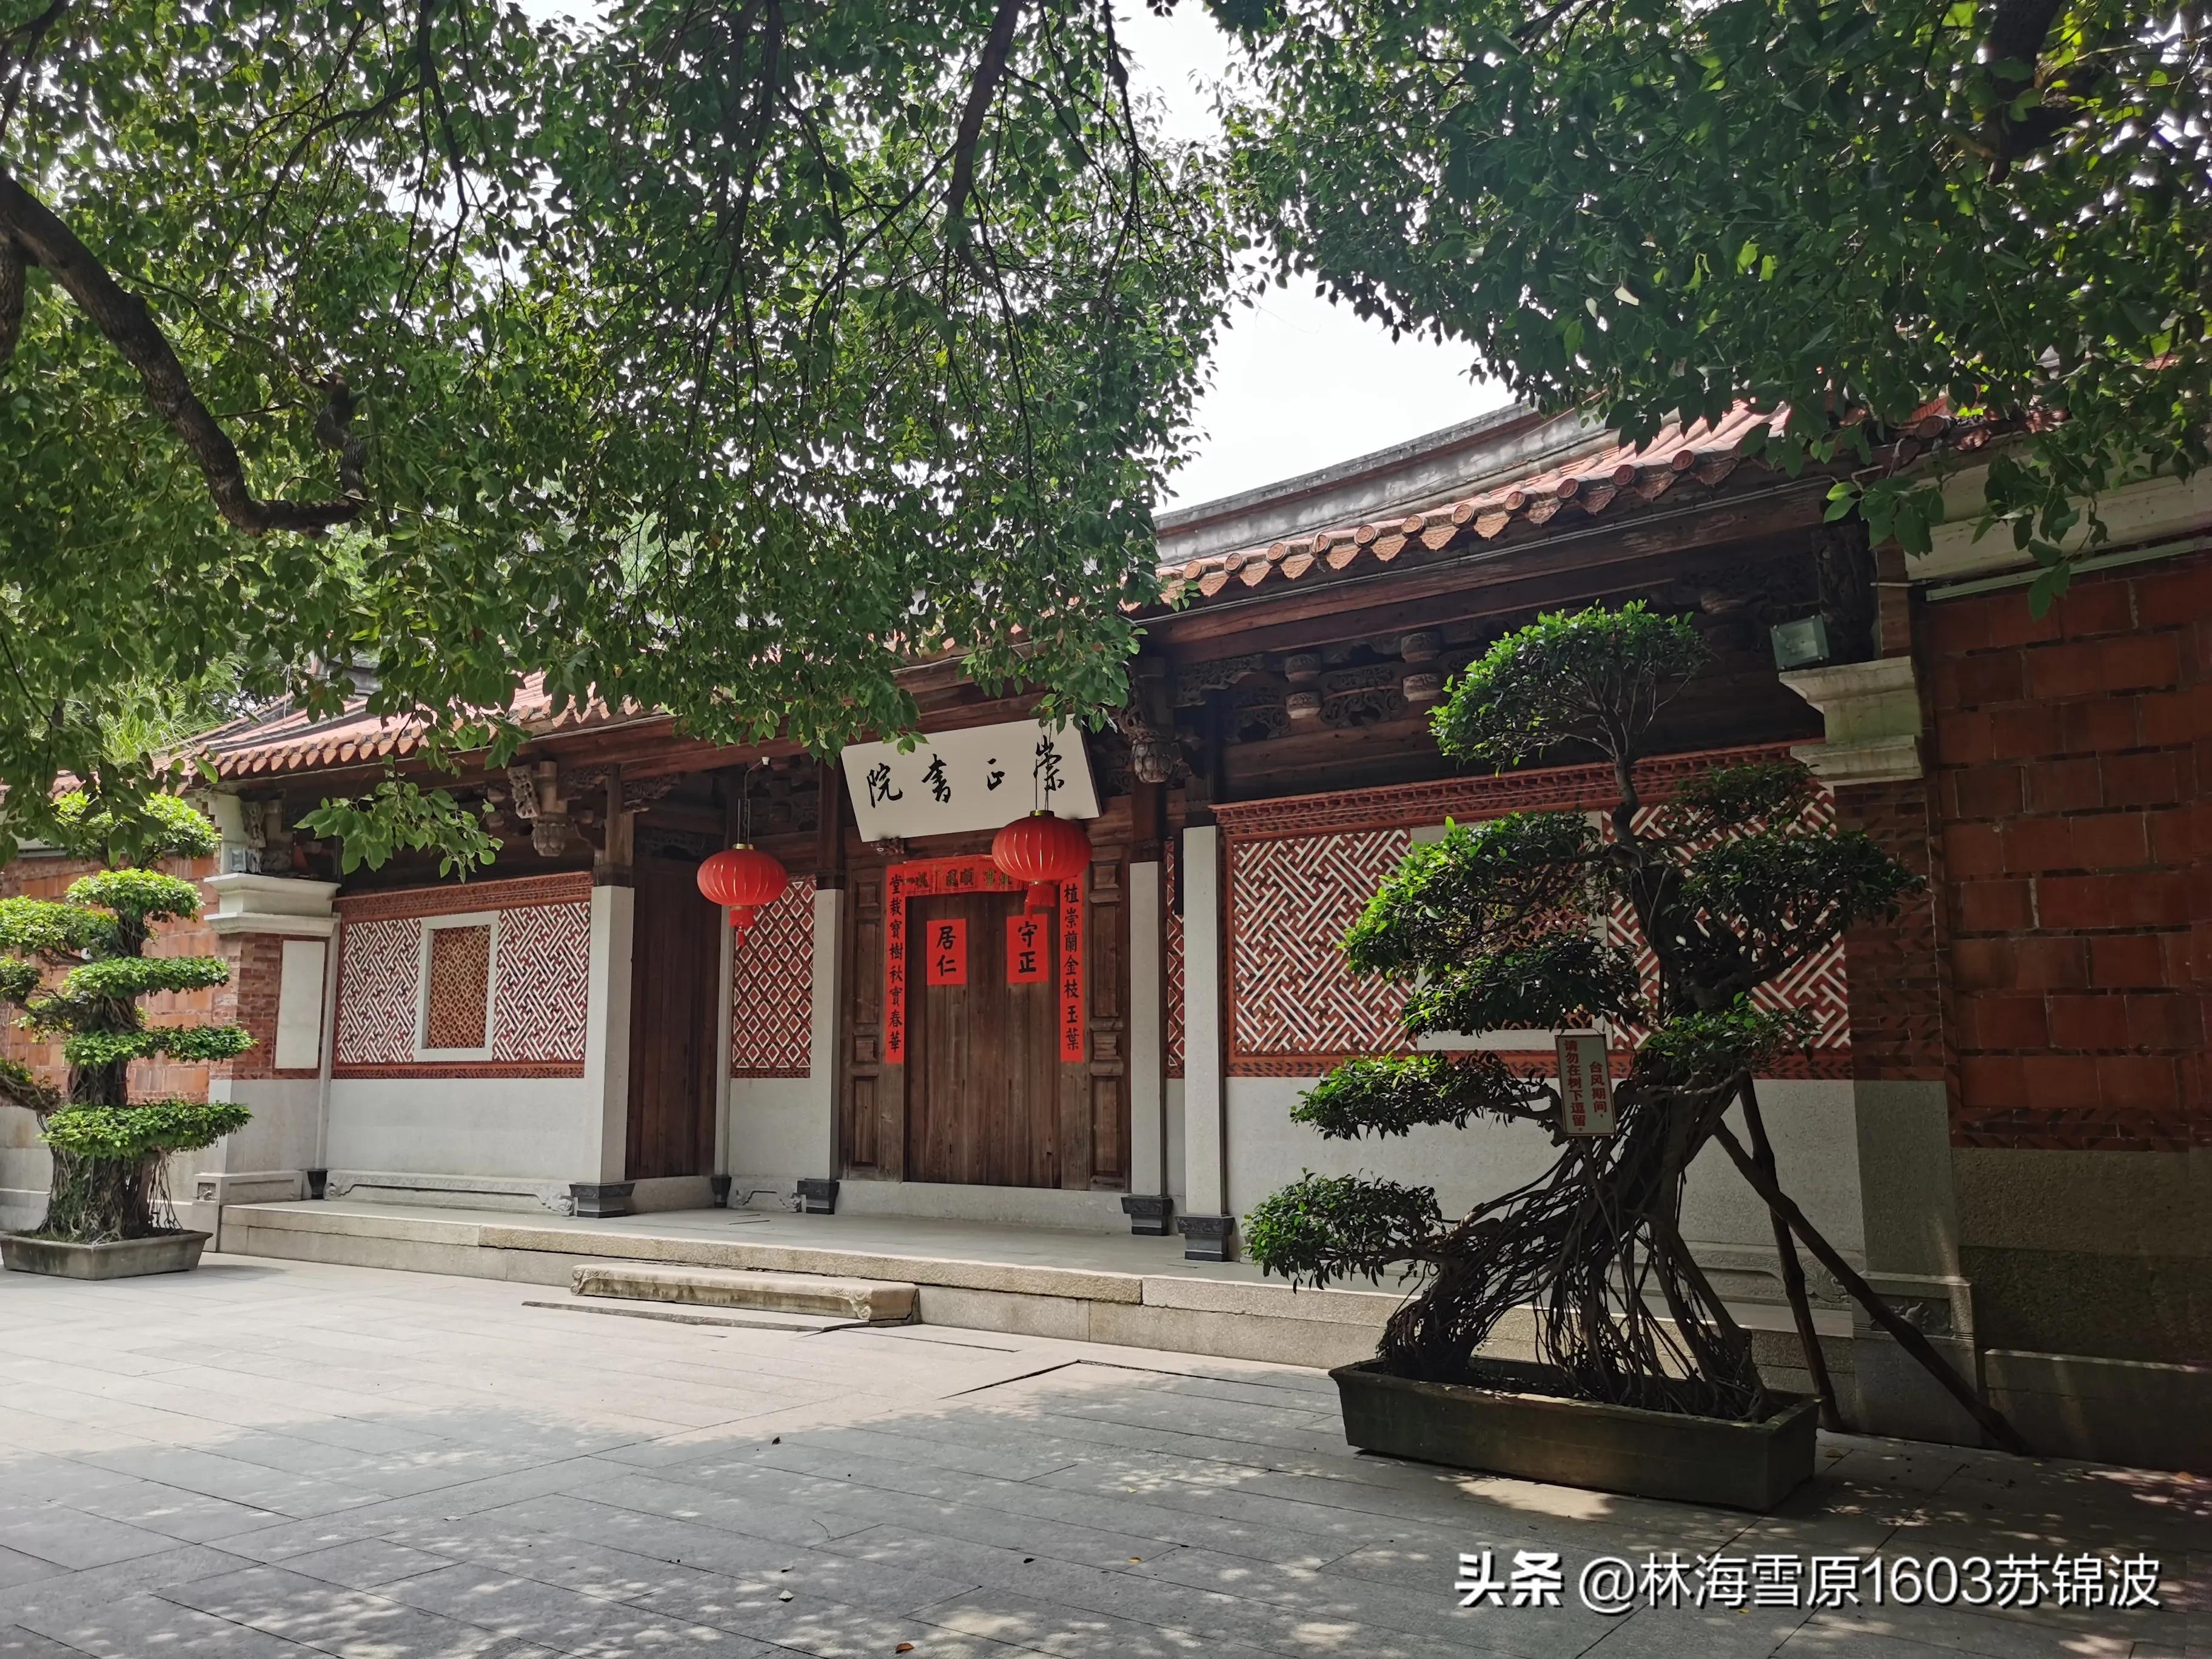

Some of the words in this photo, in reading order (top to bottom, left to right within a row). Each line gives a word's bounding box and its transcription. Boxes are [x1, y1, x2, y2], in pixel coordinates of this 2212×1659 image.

[936, 925, 957, 977] 居仁
[1017, 920, 1038, 974] 守正
[1063, 882, 1079, 1051] 植崇蘭金枝玉葉
